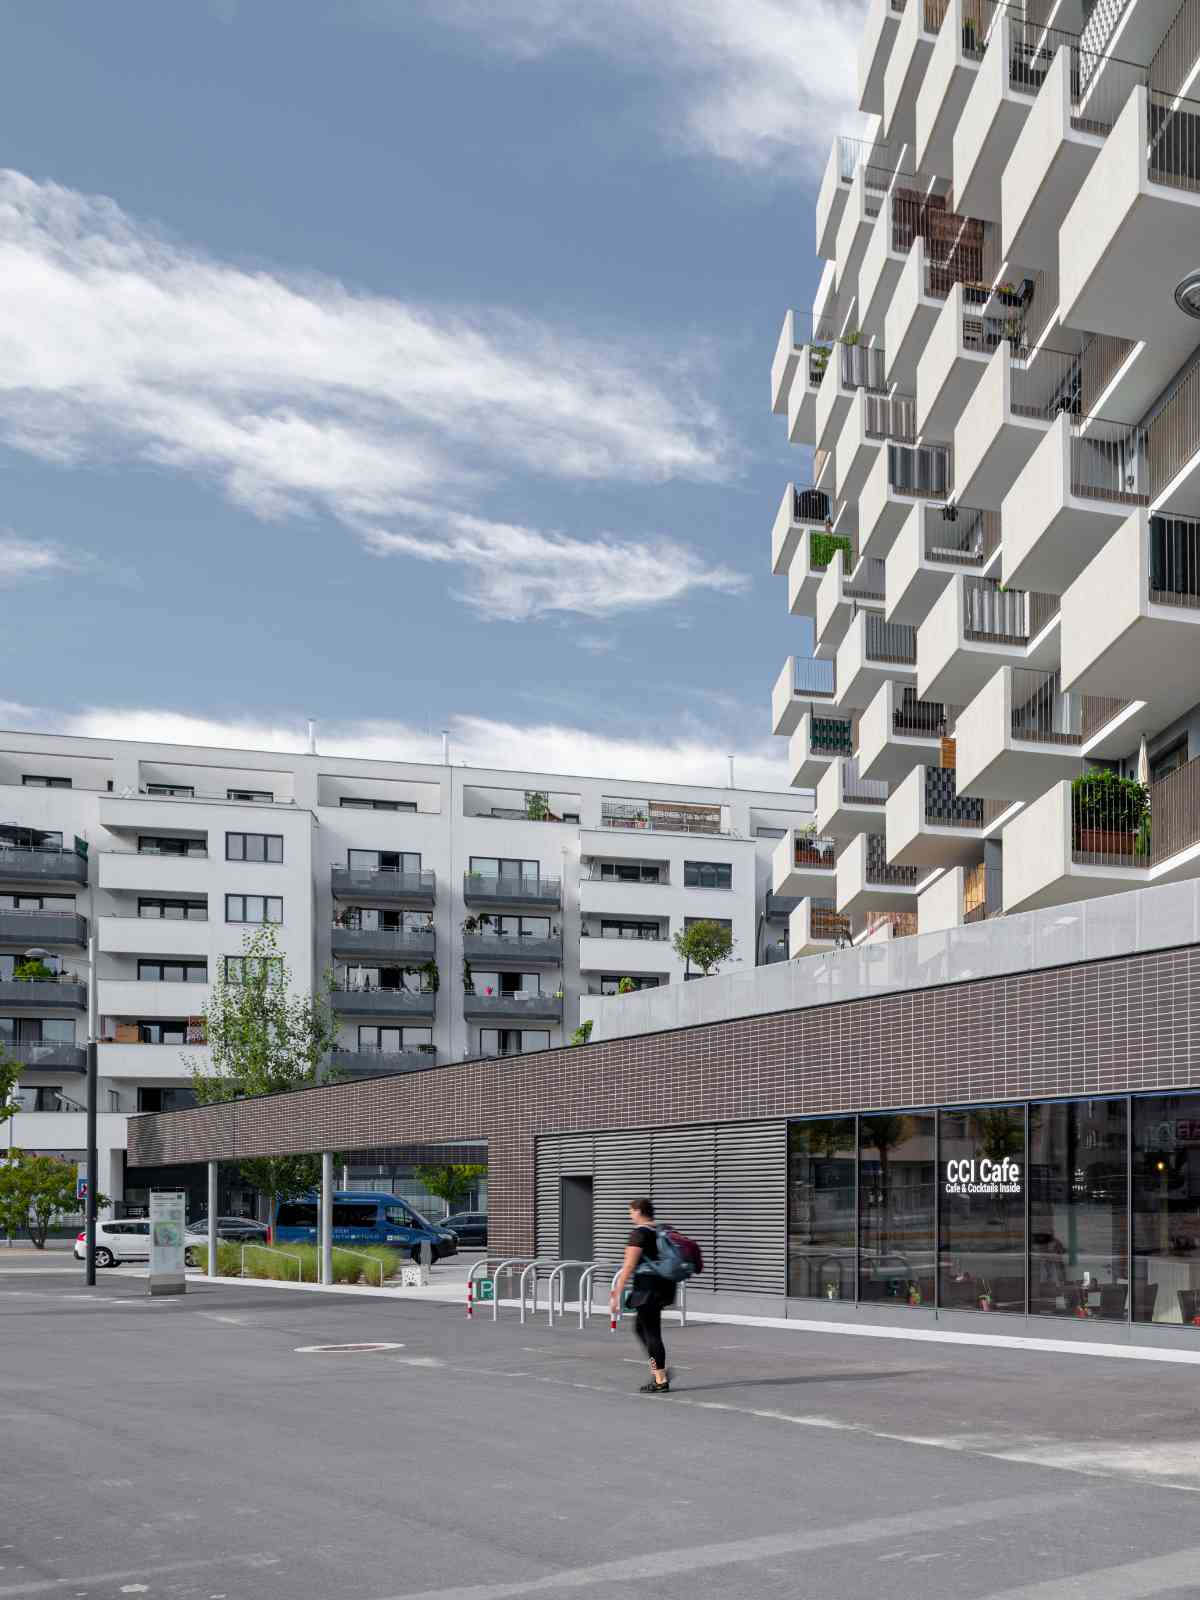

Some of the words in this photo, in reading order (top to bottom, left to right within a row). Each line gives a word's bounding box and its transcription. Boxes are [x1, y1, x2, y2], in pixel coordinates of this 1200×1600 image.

[947, 1159, 975, 1183] CCI
[980, 1157, 1019, 1183] Cafe
[945, 1183, 960, 1193] Cafe
[961, 1183, 967, 1193] &
[968, 1182, 999, 1193] Cocktails
[1000, 1182, 1021, 1193] Inside
